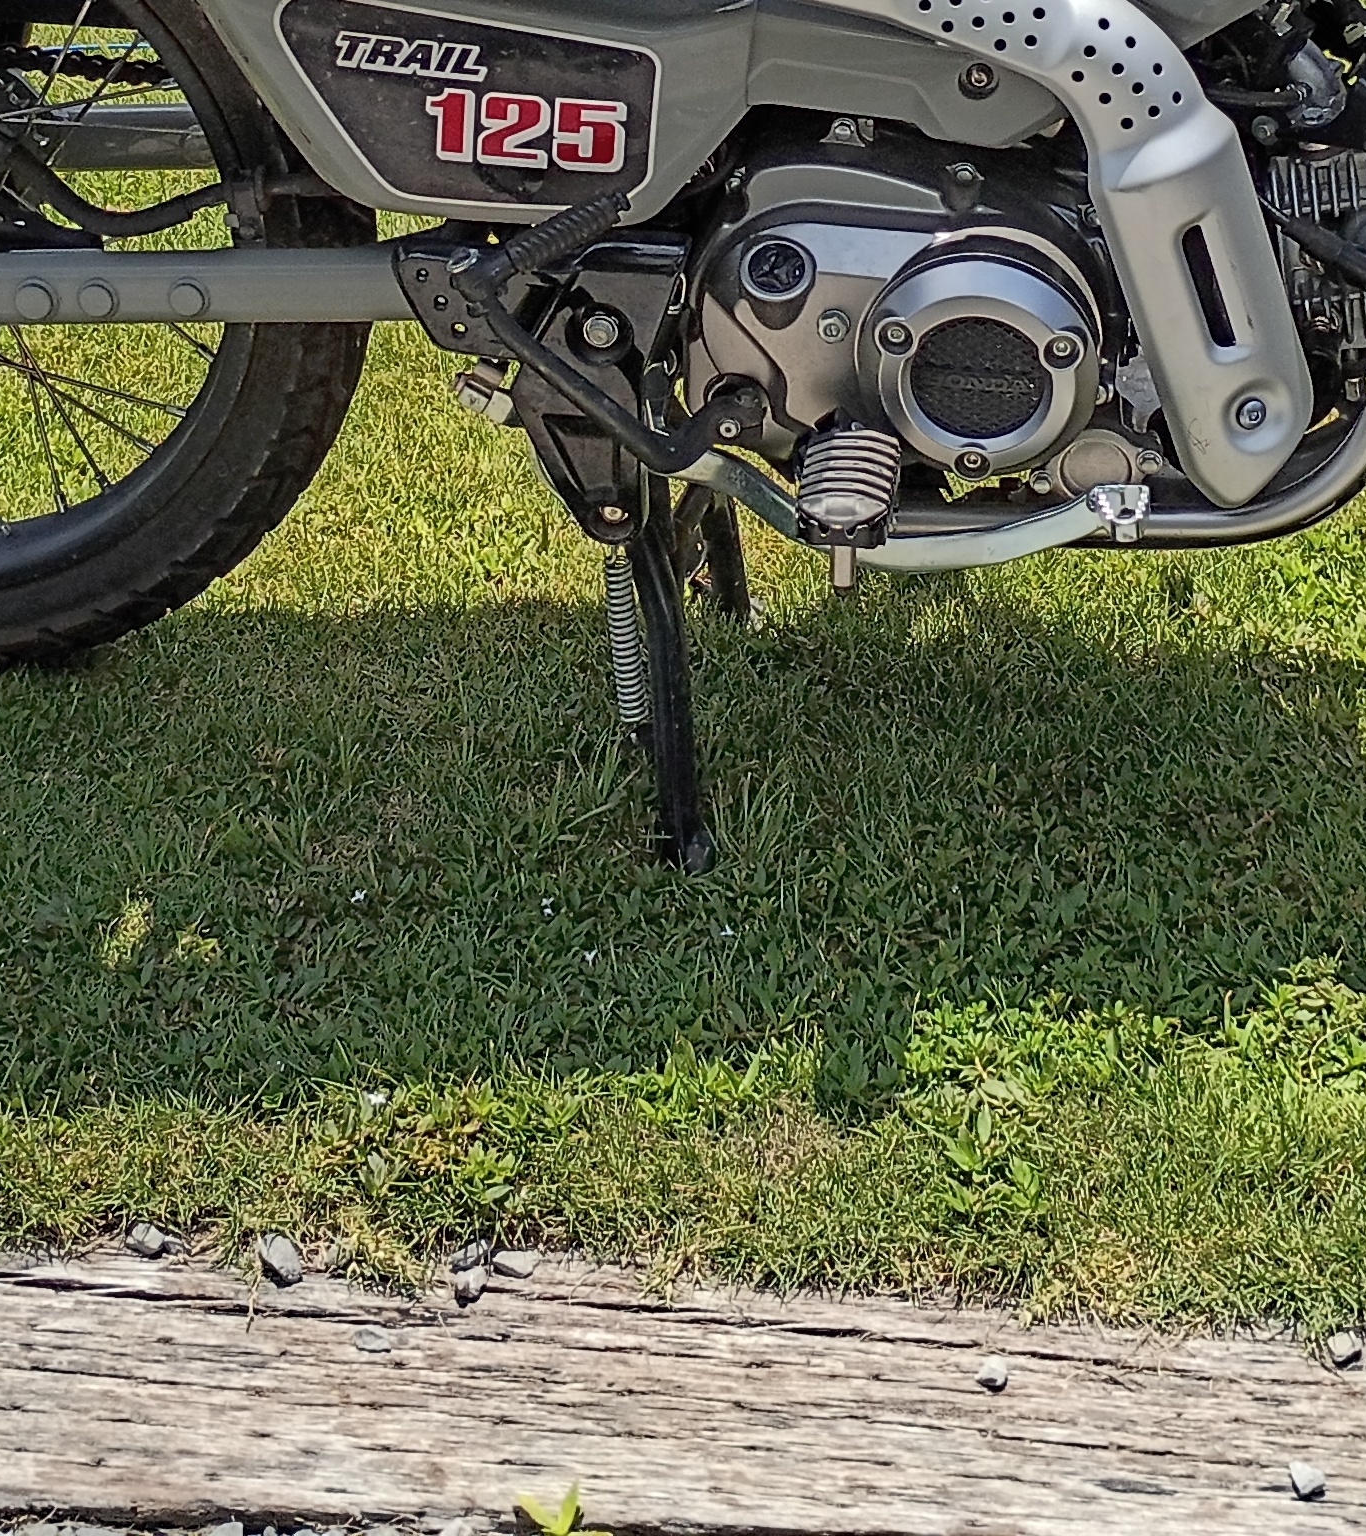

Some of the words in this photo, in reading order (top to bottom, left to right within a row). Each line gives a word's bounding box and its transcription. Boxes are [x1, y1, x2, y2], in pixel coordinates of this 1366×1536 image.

[335, 31, 488, 82] TRAIL
[426, 88, 627, 173] 125
[925, 371, 1035, 395] ONDA
